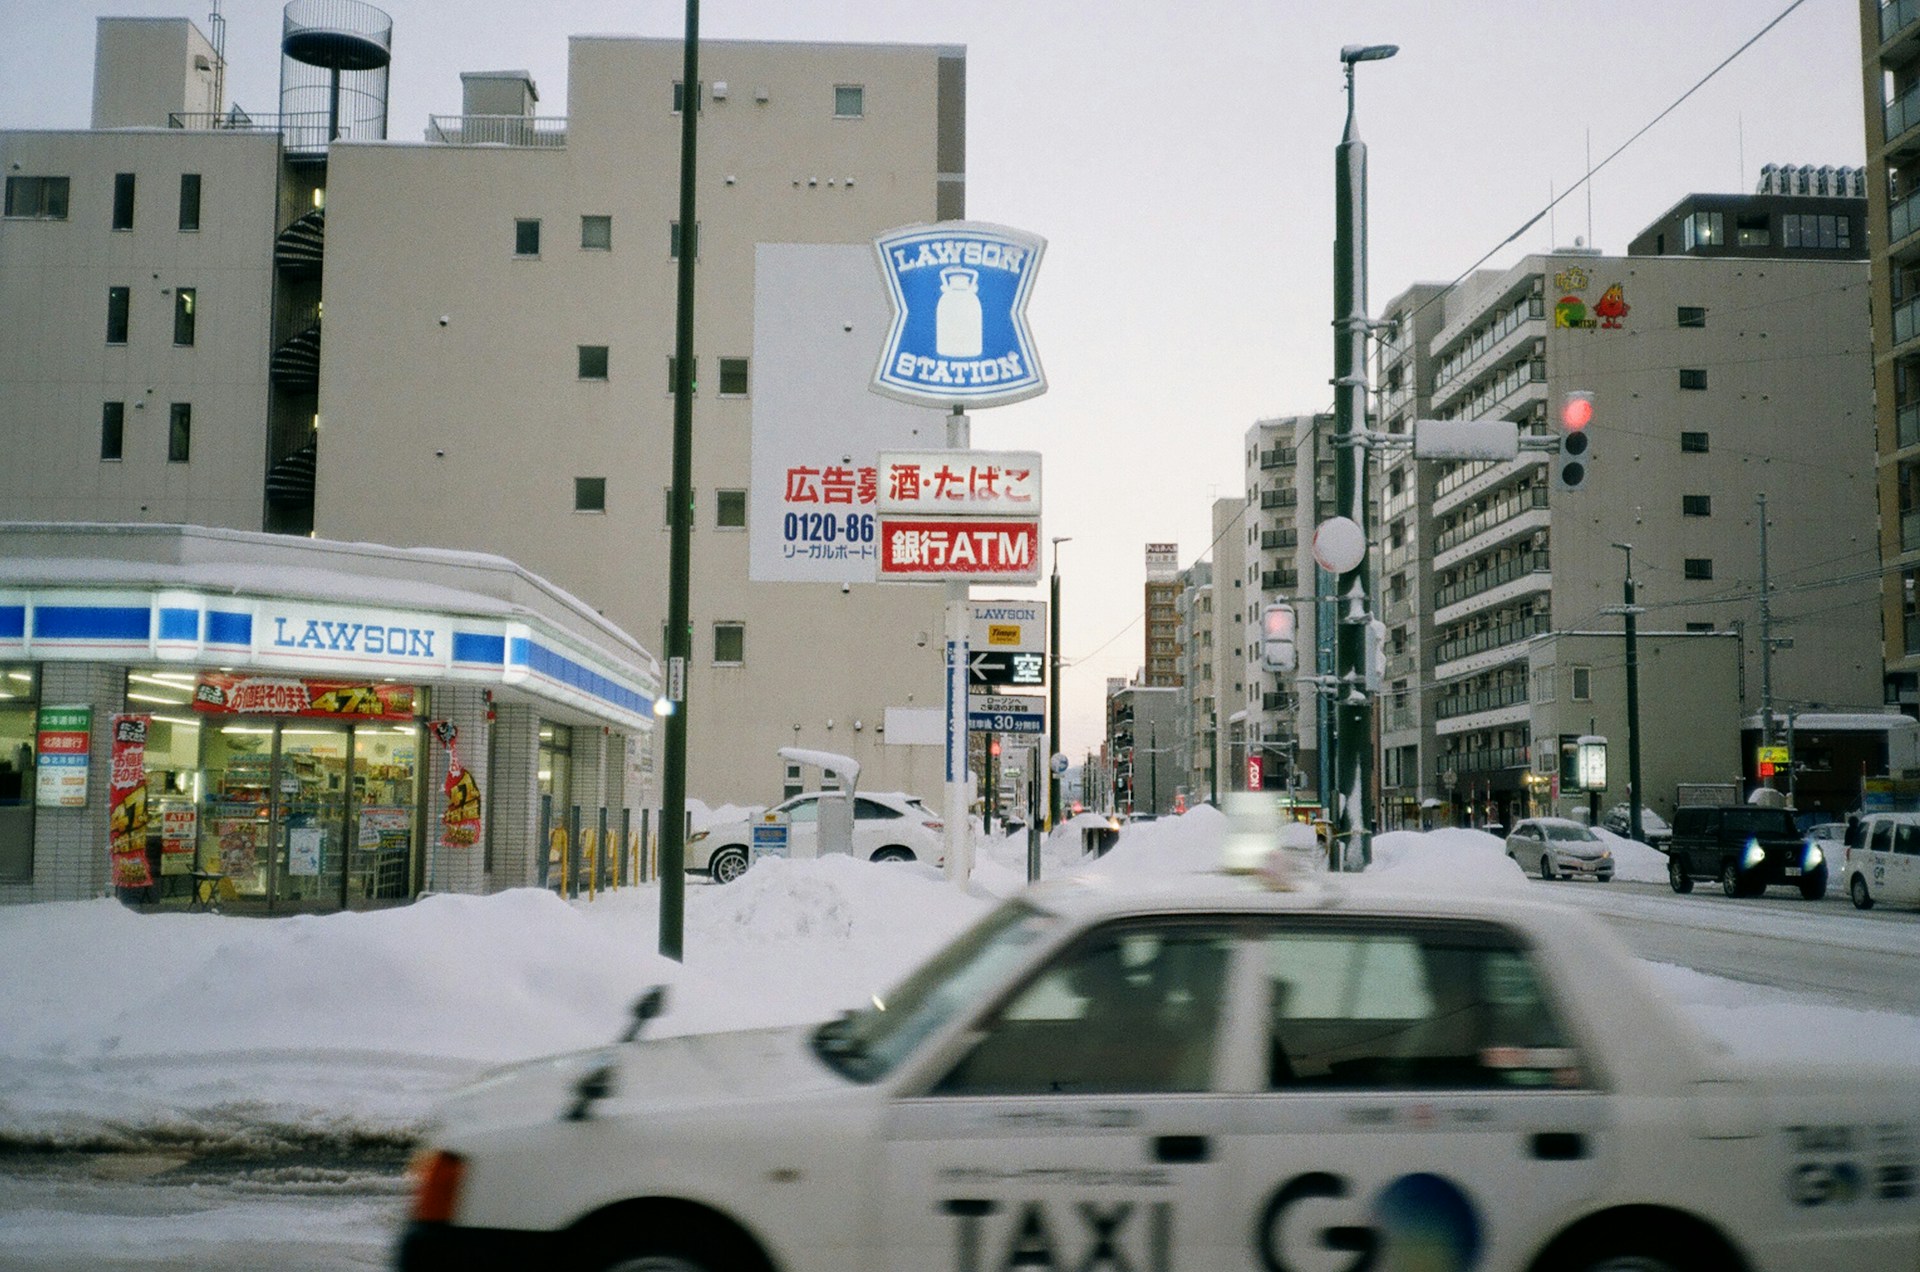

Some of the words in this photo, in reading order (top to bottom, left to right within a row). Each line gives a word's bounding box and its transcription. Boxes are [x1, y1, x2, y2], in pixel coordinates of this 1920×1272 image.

[894, 242, 1024, 274] LAWSON
[895, 351, 1024, 385] STATION
[888, 463, 1032, 501] 酒・たばこ
[784, 512, 877, 543] 0120-86
[891, 530, 1030, 566] 銀行ATM
[975, 608, 1036, 620] LAWSON
[274, 615, 435, 658] LAWSON
[1013, 653, 1043, 683] 空
[937, 1198, 1175, 1272] TAXI
